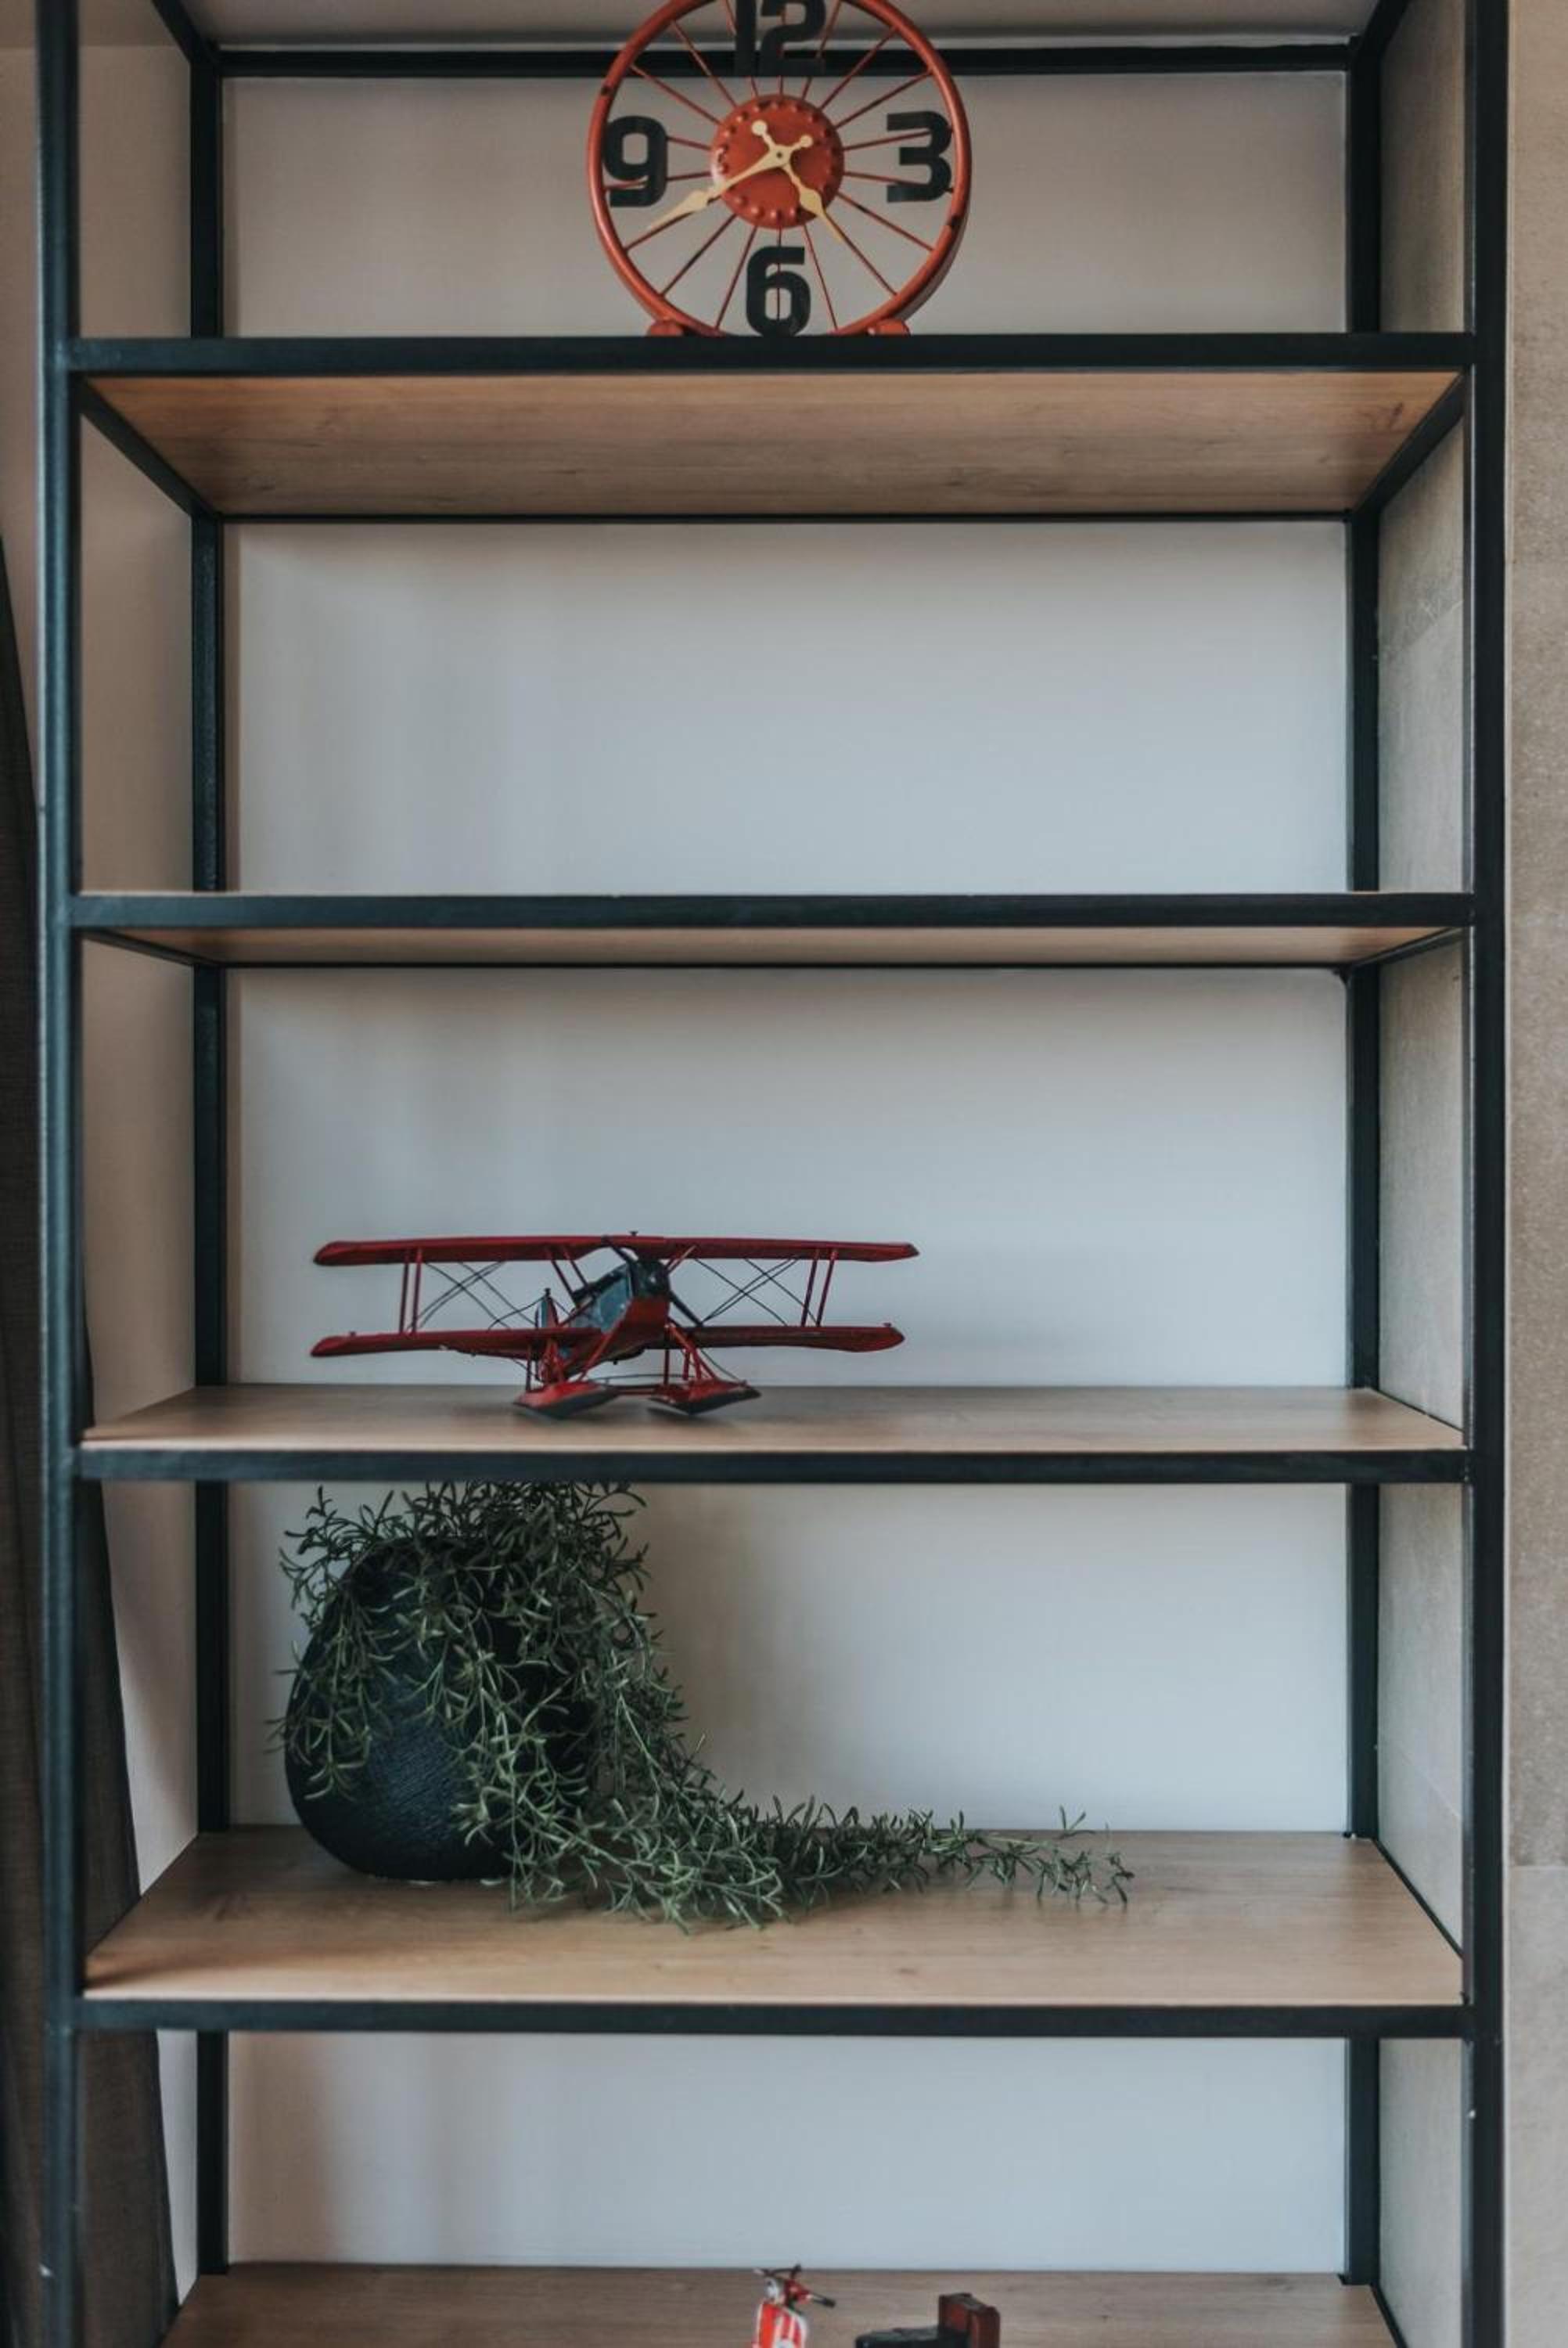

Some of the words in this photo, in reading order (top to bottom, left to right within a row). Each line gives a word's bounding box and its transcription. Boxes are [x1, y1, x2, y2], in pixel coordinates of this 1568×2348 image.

[735, 0, 826, 76] 12
[603, 116, 667, 207] 9
[886, 110, 952, 203] 3
[746, 246, 811, 337] 6
